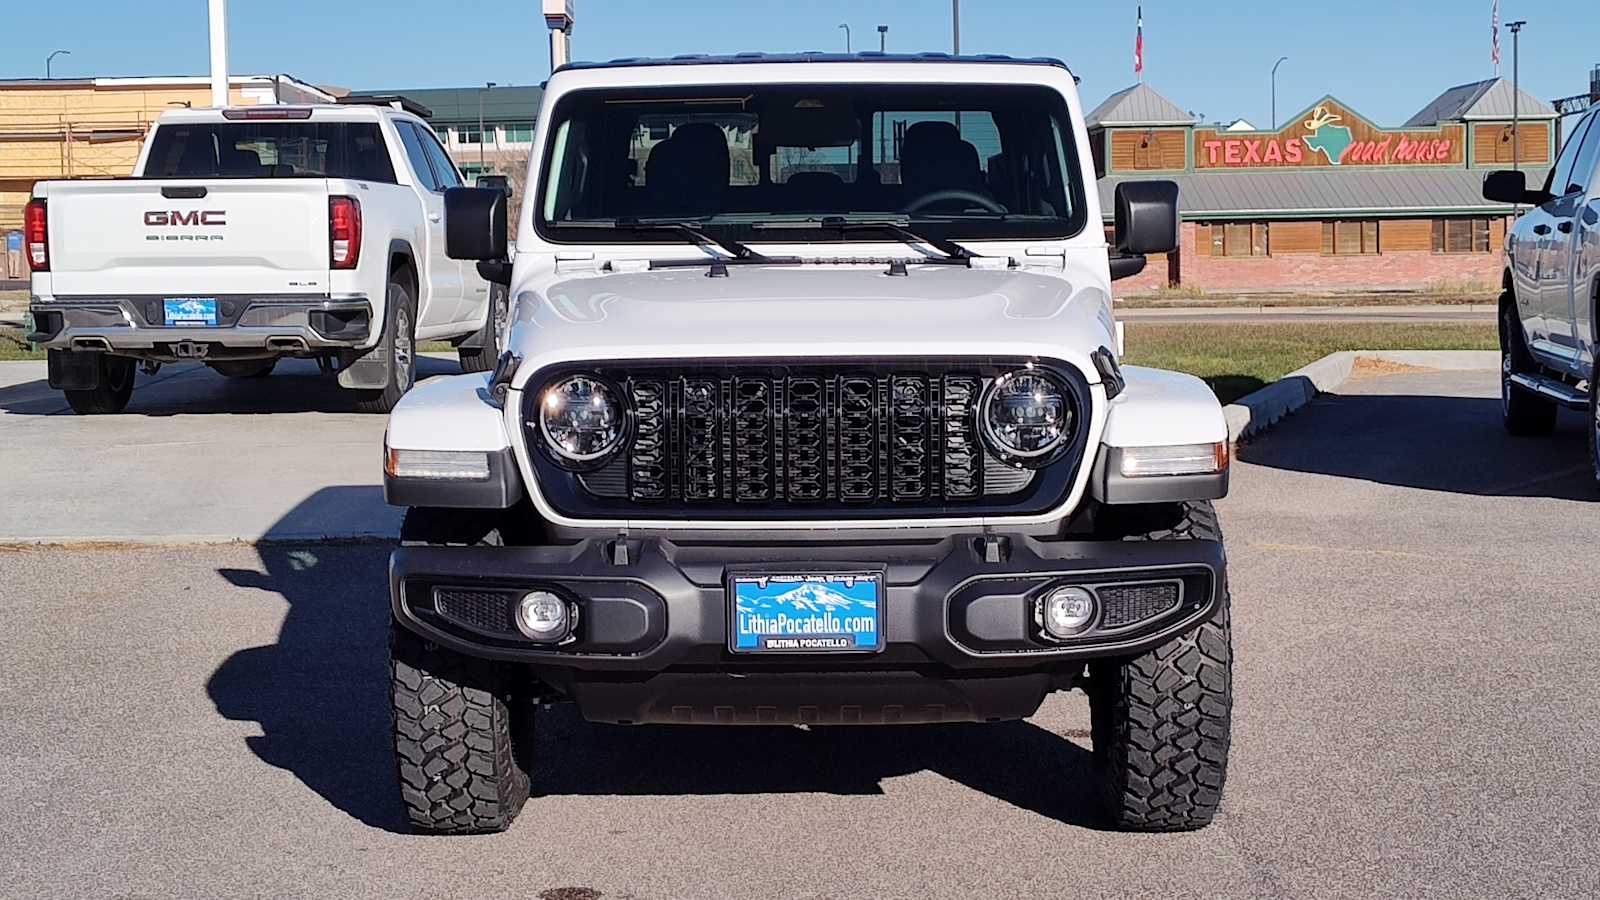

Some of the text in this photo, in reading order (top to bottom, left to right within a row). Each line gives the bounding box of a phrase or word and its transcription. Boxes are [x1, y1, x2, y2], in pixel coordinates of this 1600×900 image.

[1204, 134, 1451, 164] TEXAS road house
[144, 210, 226, 226] GMC
[740, 612, 874, 634] LithiaPocatello.com
[800, 638, 848, 648] POCATELLO
